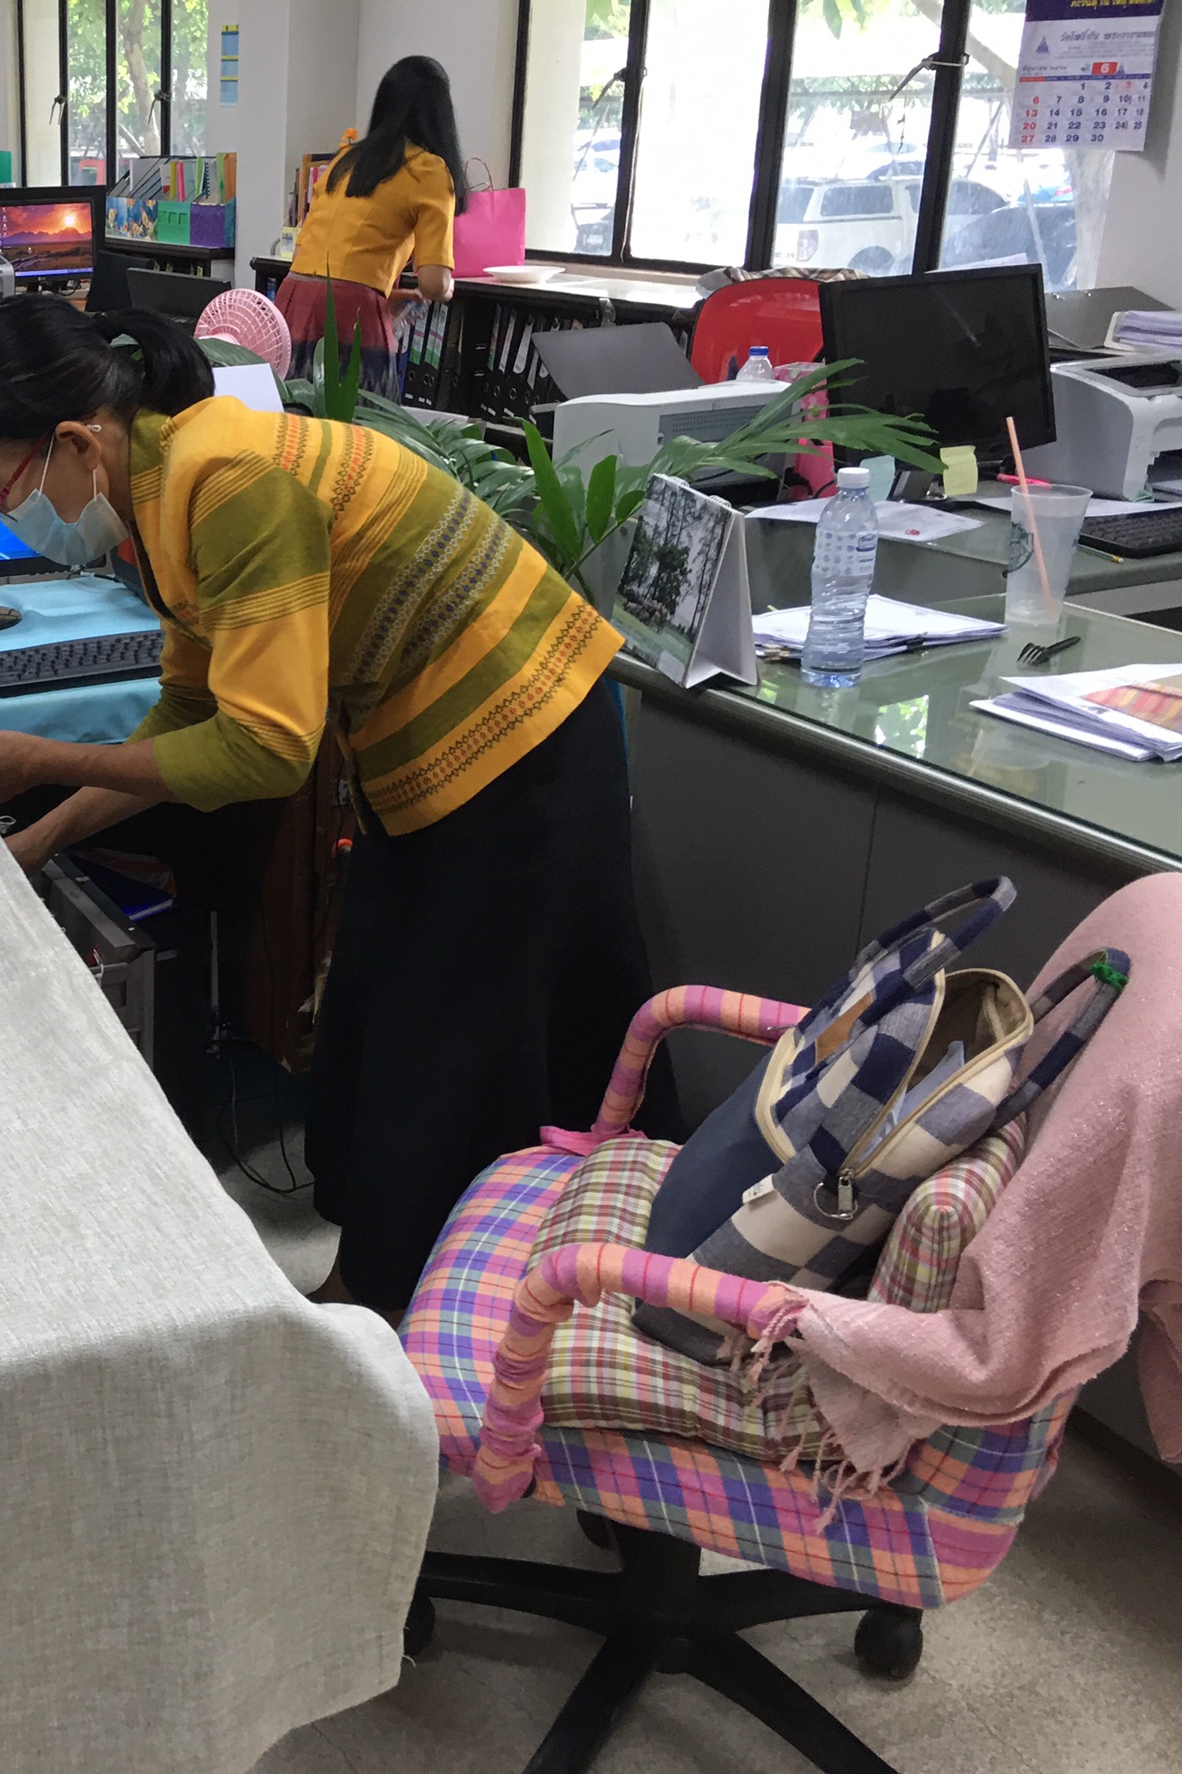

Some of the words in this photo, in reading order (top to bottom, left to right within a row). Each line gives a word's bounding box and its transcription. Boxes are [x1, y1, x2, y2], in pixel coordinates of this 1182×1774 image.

[1100, 63, 1110, 74] 6
[1080, 82, 1086, 91] 1
[1104, 81, 1112, 90] 2
[1143, 82, 1149, 90] 4
[1032, 96, 1040, 104] 6
[1057, 96, 1063, 104] 7
[1077, 95, 1085, 104] 8
[1103, 95, 1110, 103] 9
[1025, 109, 1038, 117] 13
[1049, 109, 1060, 117] 14
[1070, 108, 1083, 117] 15
[1095, 108, 1108, 116] 16
[1117, 108, 1128, 116] 17
[1135, 108, 1145, 116] 18
[1022, 121, 1037, 130] 20
[1046, 121, 1058, 130] 21
[1068, 121, 1082, 130] 22
[1092, 121, 1106, 130] 23
[1114, 121, 1126, 129] 24
[1133, 121, 1143, 130] 25
[1021, 134, 1035, 143] 27
[1044, 134, 1057, 143] 28
[1065, 134, 1080, 142] 29
[1090, 133, 1104, 142] 30
